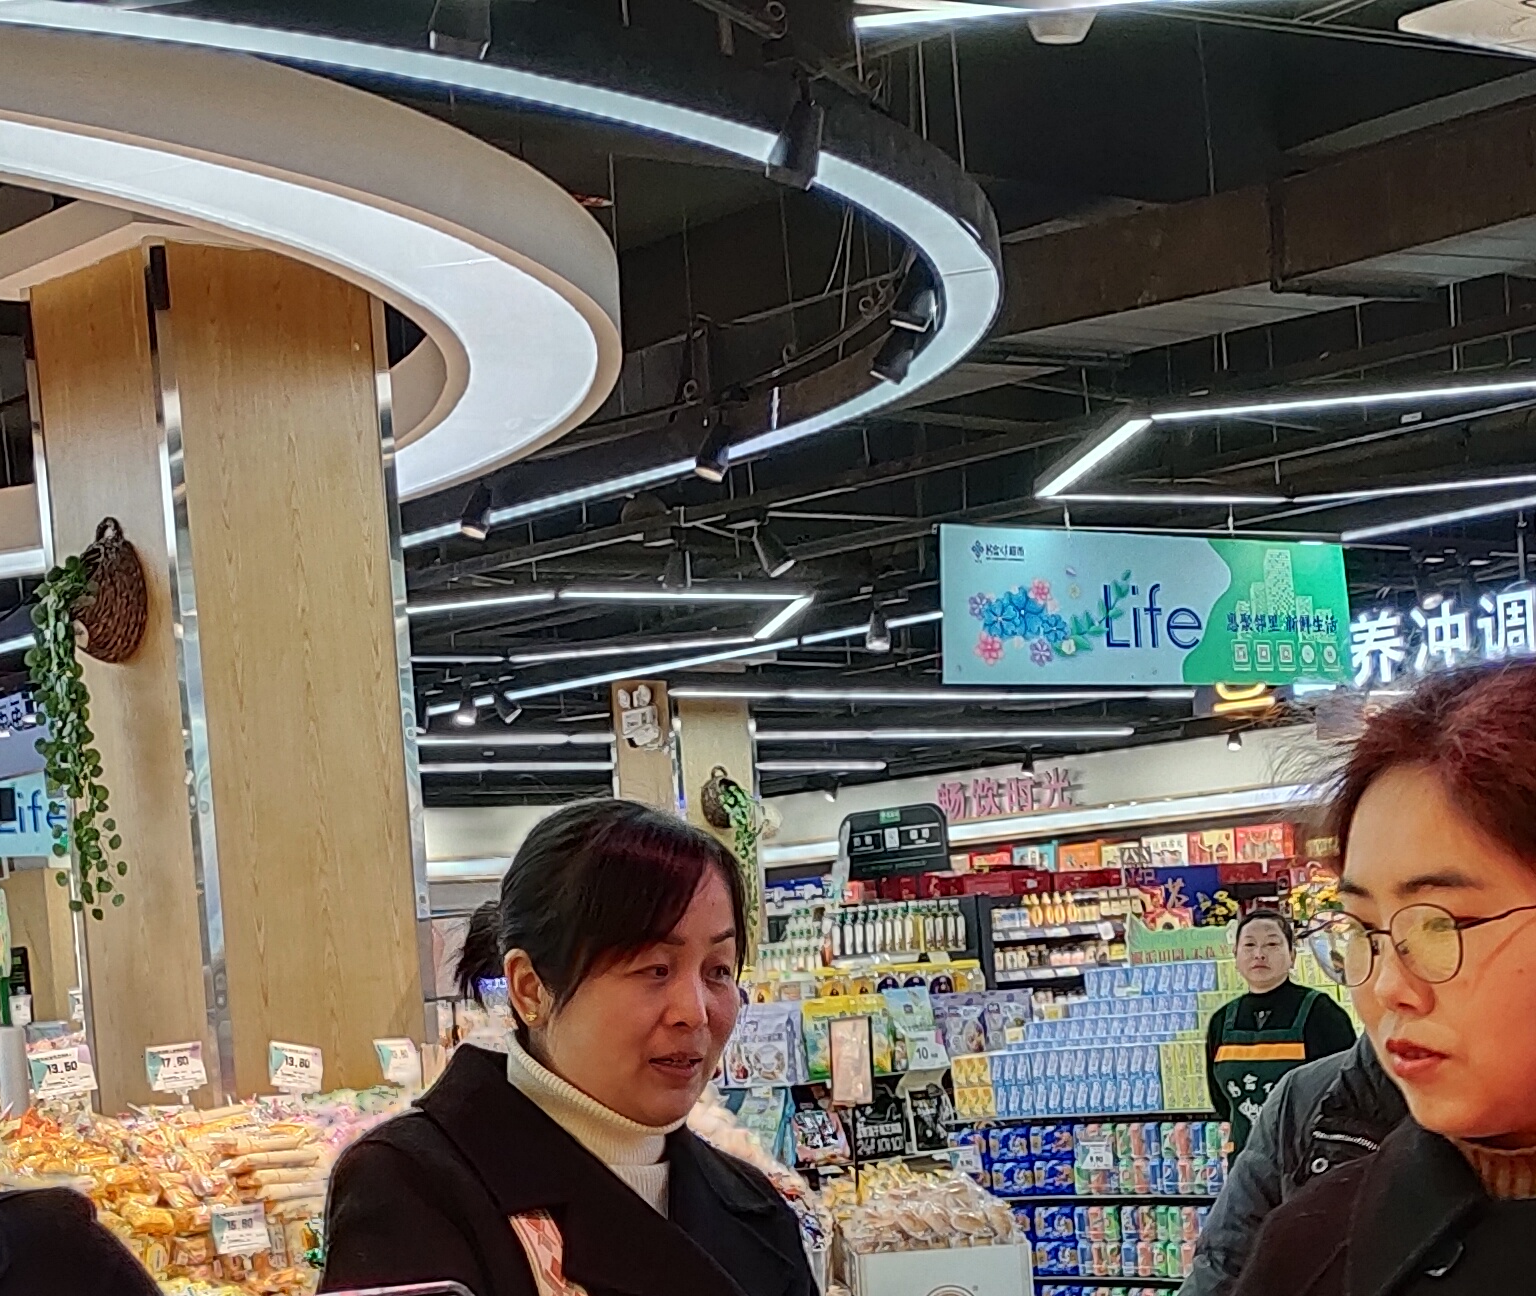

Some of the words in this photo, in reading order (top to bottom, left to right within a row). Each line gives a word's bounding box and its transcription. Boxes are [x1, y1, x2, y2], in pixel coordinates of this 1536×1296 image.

[1102, 583, 1203, 649] Life
[937, 767, 1073, 820] 畅饮时光
